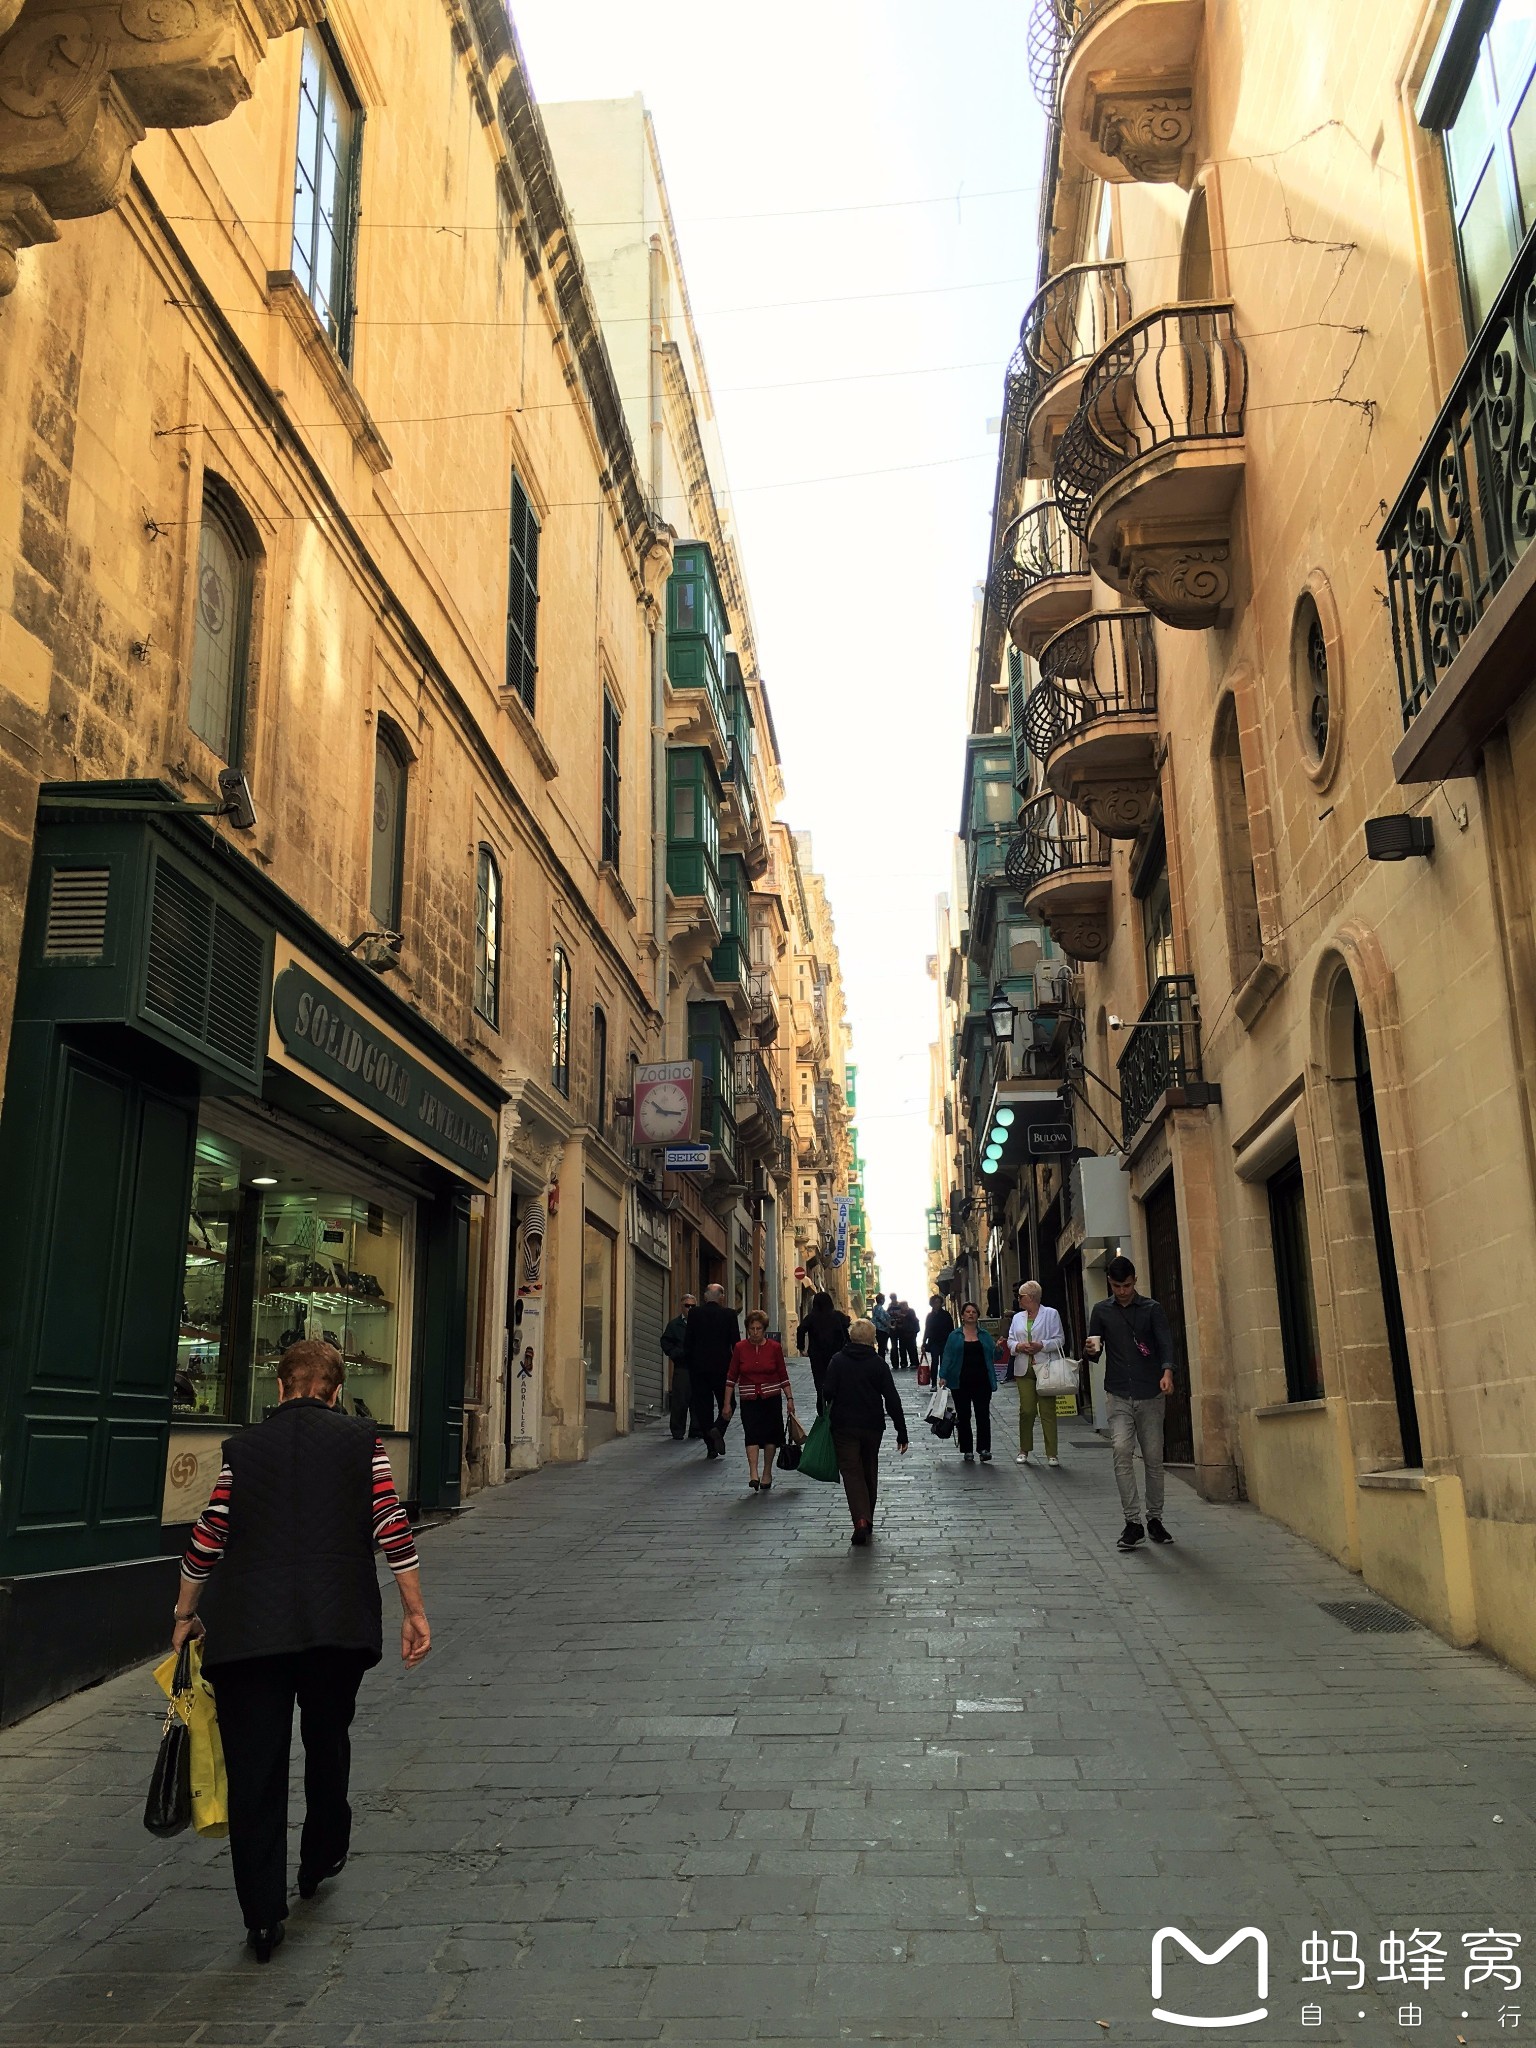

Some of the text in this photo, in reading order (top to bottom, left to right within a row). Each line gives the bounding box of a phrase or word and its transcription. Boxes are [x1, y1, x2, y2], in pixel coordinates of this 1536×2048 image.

[294, 992, 412, 1107] SOLIDGOLD
[640, 1065, 692, 1082] Zodiac
[1033, 1133, 1067, 1143] BULOVA
[667, 1153, 706, 1163] SEIKO
[838, 1204, 847, 1235] AGIUS
[833, 1240, 845, 1266] BROS
